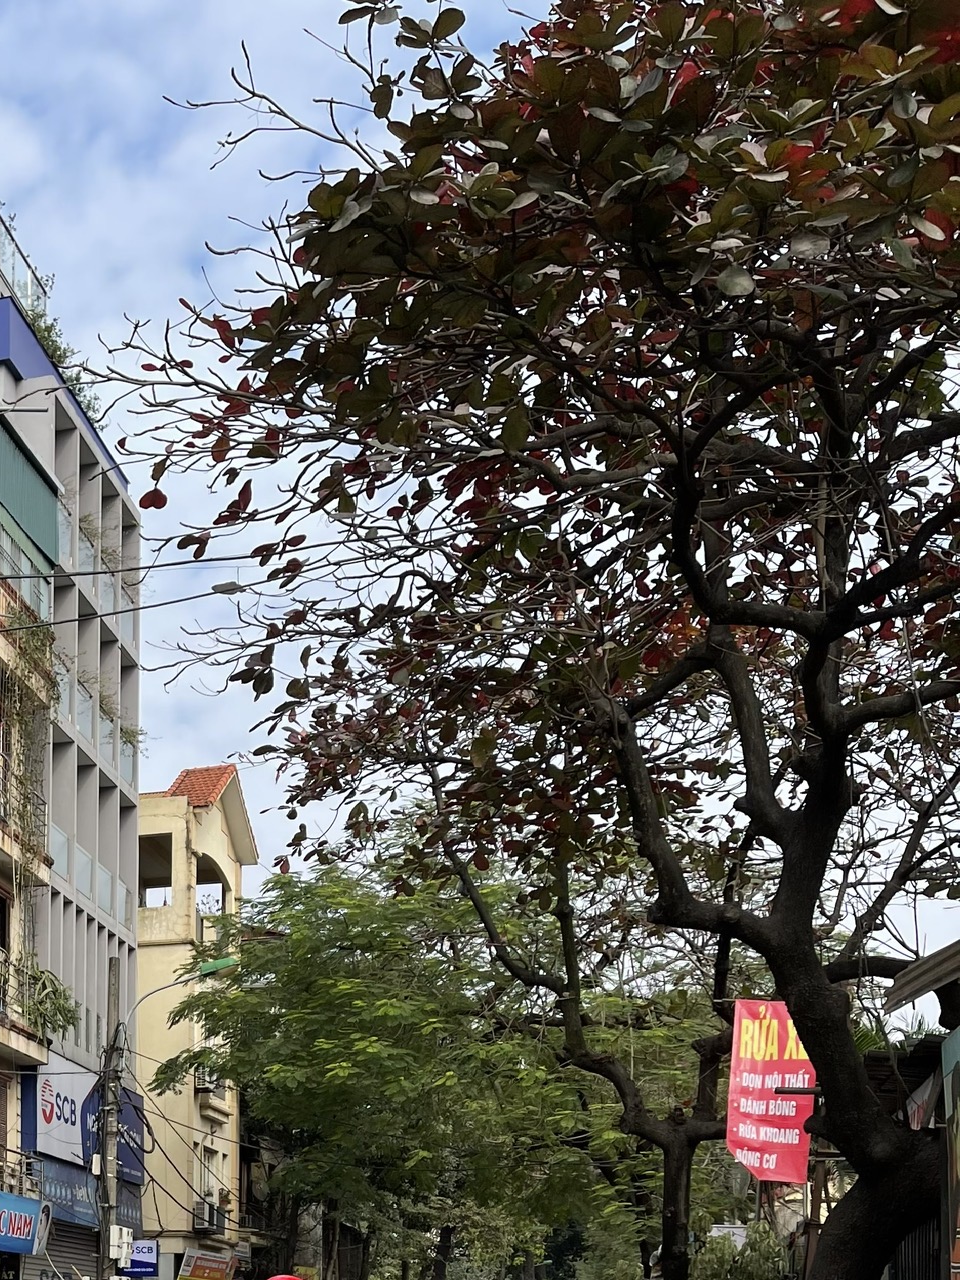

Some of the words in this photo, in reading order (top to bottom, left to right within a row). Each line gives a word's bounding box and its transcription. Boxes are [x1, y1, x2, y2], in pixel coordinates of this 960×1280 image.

[739, 1005, 779, 1061] RỬA
[742, 1071, 760, 1091] DỌN
[784, 1069, 810, 1089] THẤT
[55, 1091, 77, 1127] SCB
[739, 1097, 767, 1116] ĐÁNH
[768, 1097, 797, 1117] BÓNG
[738, 1120, 757, 1140] RỬA
[759, 1128, 800, 1145] KHOANG
[763, 1153, 778, 1169] CƠ
[6, 1210, 35, 1240] NAM
[135, 1246, 154, 1254] SCB
